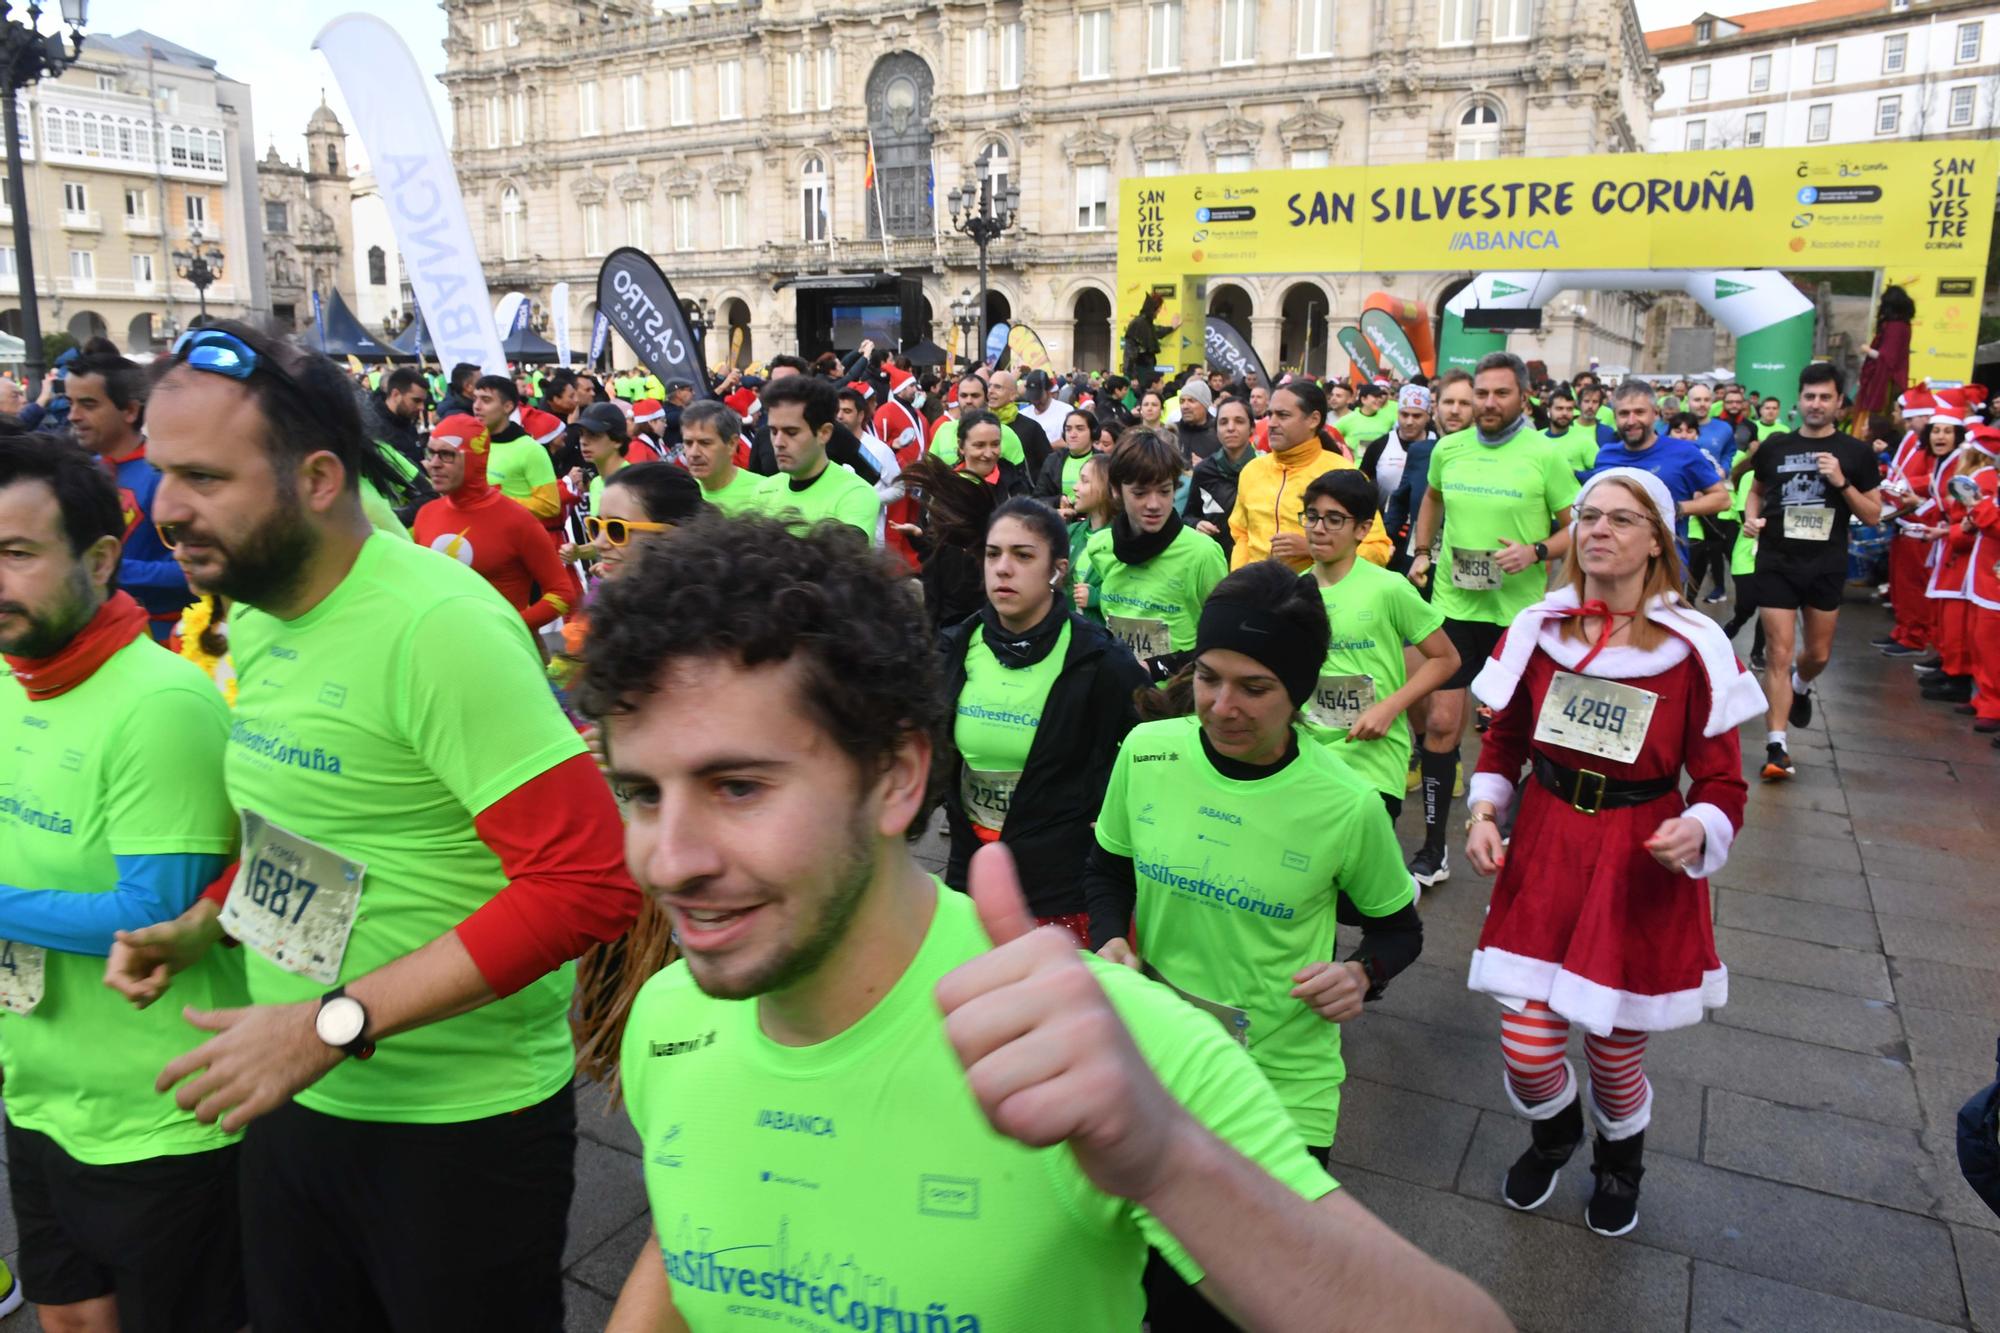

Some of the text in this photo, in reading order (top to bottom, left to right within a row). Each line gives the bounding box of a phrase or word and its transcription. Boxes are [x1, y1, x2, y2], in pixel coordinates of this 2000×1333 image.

[1933, 158, 1975, 177] SAN
[1138, 190, 1165, 205] SAN
[1931, 178, 1971, 199] SIL
[1287, 170, 1754, 227] SAN SILVESTRE CORUÑA
[1138, 206, 1165, 223] SIL
[1929, 199, 1969, 218] VES
[1138, 223, 1164, 238] VES
[1927, 219, 1967, 238] TRE
[1137, 239, 1163, 254] TRE
[1794, 515, 1824, 529] 2009
[1119, 631, 1152, 653] 414
[1317, 689, 1360, 711] 4545
[1562, 695, 1627, 734] 4299
[1133, 752, 1166, 763] luanvi
[969, 783, 1015, 813] 225
[243, 852, 319, 926] 1687
